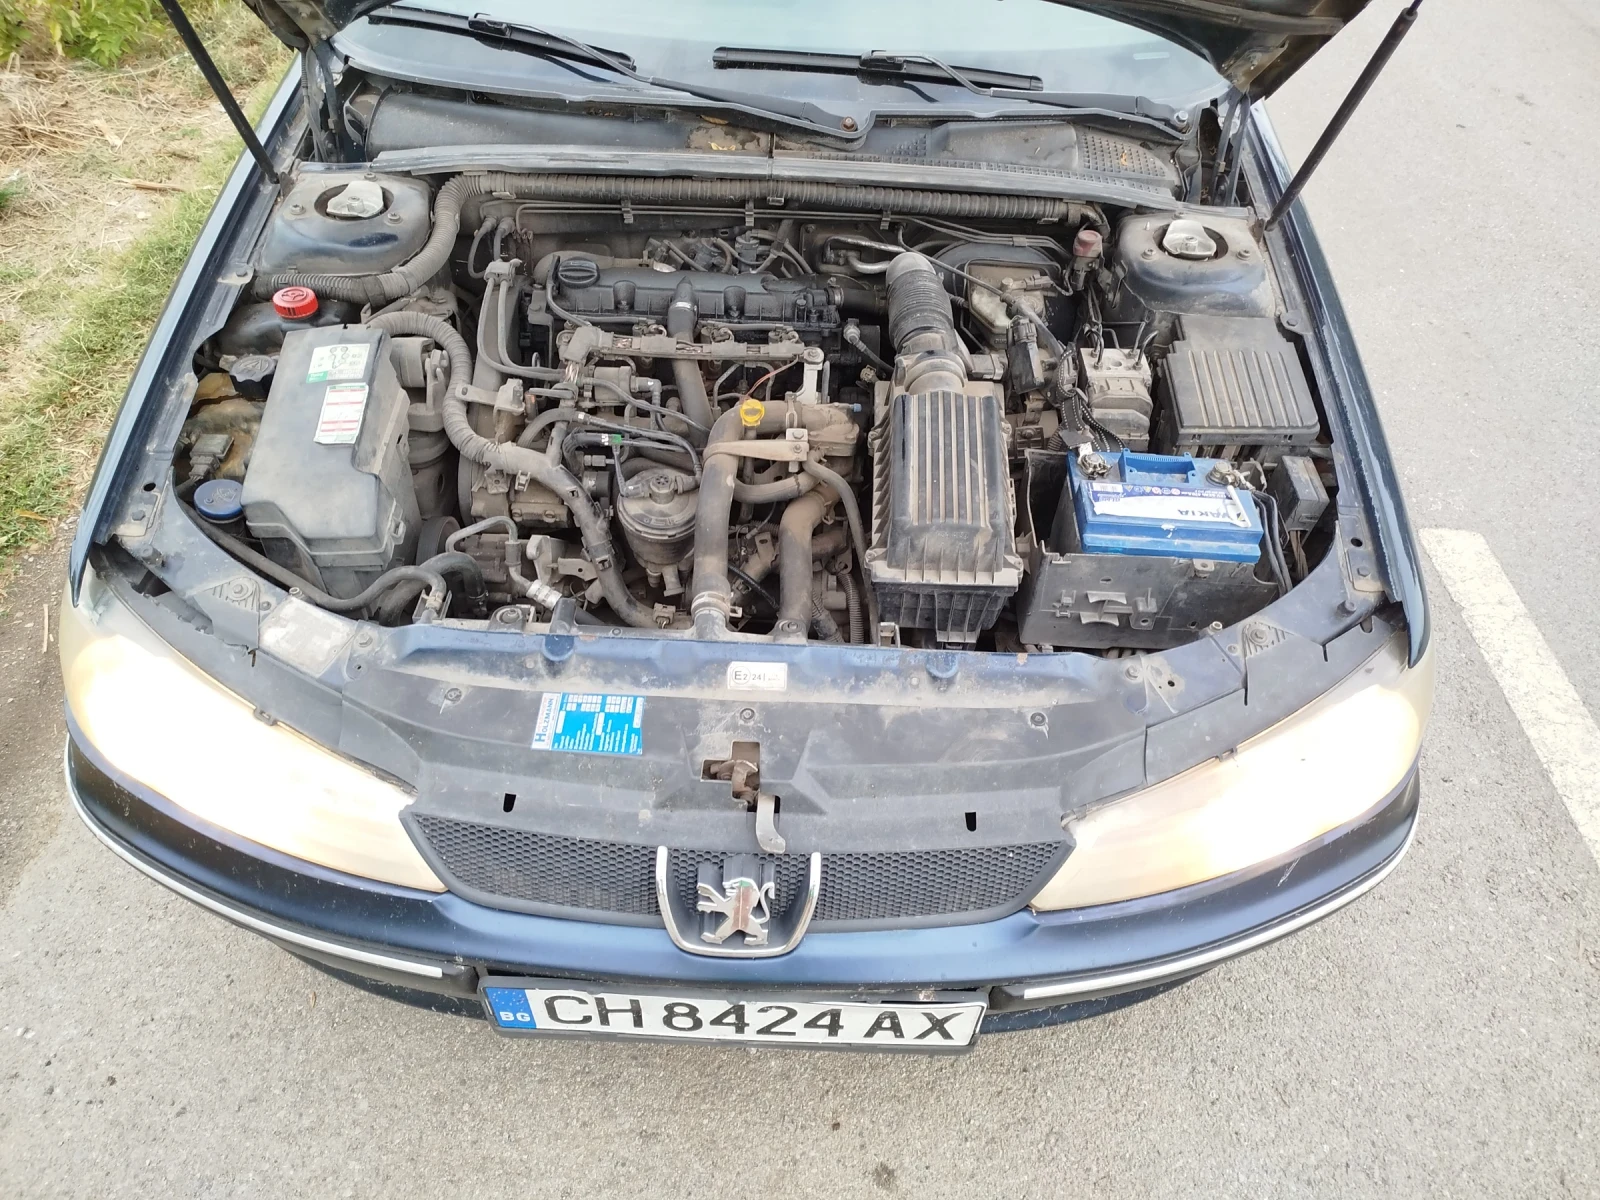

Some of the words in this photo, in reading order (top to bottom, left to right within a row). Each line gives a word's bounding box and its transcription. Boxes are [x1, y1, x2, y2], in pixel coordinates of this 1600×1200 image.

[535, 698, 554, 742] HOLZMANN
[499, 1011, 531, 1022] BG
[544, 995, 644, 1028] CH
[662, 1001, 845, 1038] 8424
[863, 1010, 965, 1041] AX
